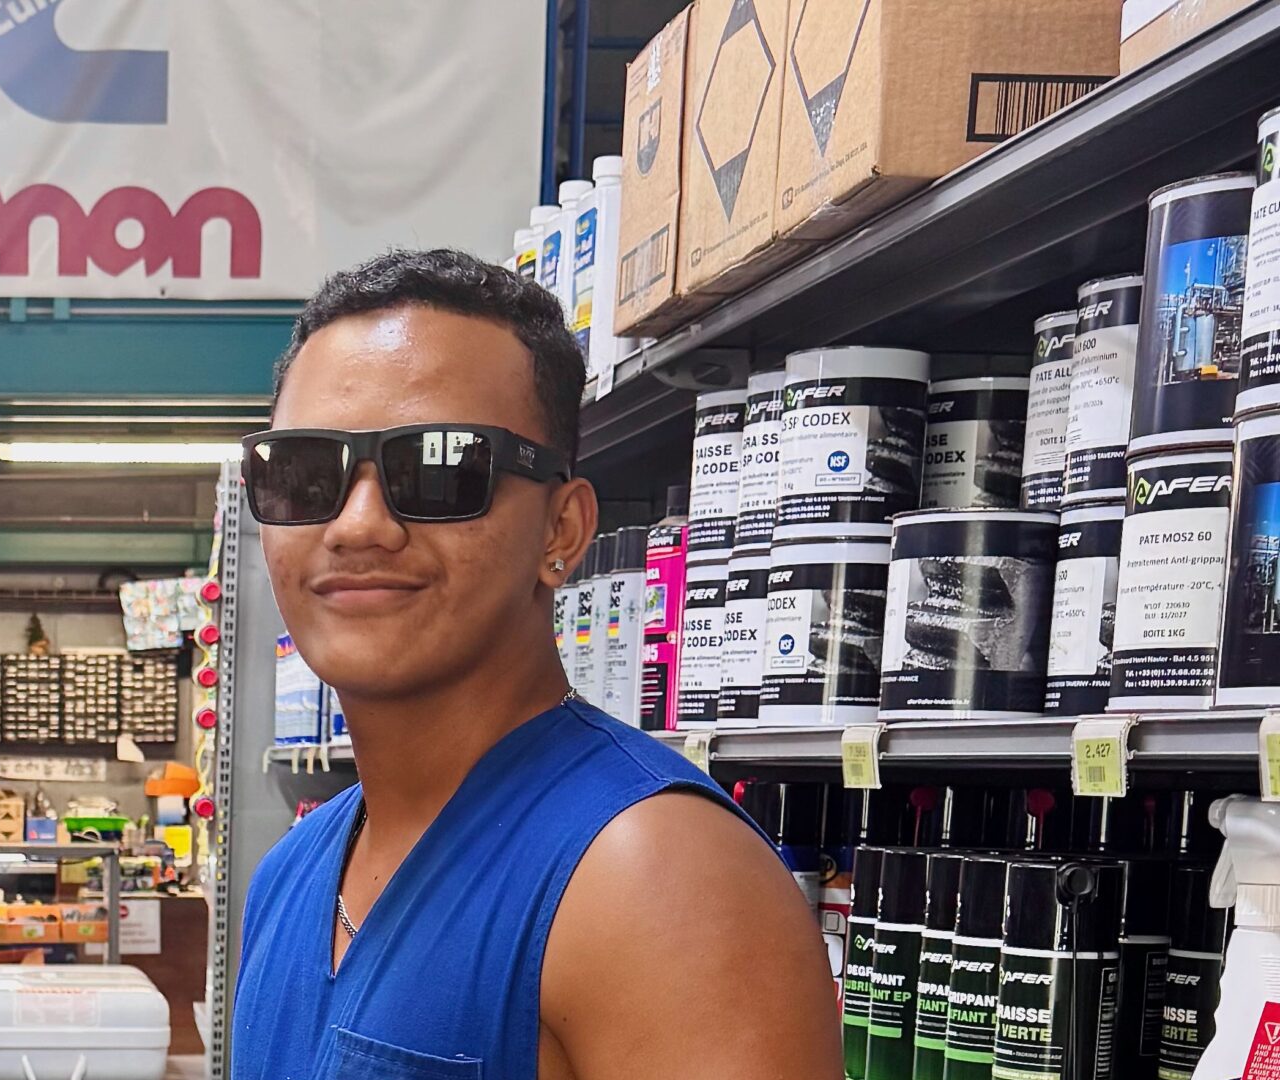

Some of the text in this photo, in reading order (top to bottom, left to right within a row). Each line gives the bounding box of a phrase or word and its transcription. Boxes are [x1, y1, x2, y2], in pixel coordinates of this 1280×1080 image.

[1082, 338, 1097, 351] 600
[791, 385, 846, 406] AFER
[802, 412, 851, 427] CODEX
[829, 455, 846, 467] NSF
[1139, 531, 1212, 545] PATE MOS2 60
[1143, 628, 1186, 639] BOITE 1KG
[1086, 744, 1111, 759] 2.427
[1002, 971, 1055, 986] AFER
[893, 991, 912, 1003] EP
[1001, 1023, 1052, 1042] VERTE
[1253, 1056, 1261, 1064] TO
[1254, 1049, 1269, 1058] AND
[1249, 1069, 1270, 1078] CAUSE
